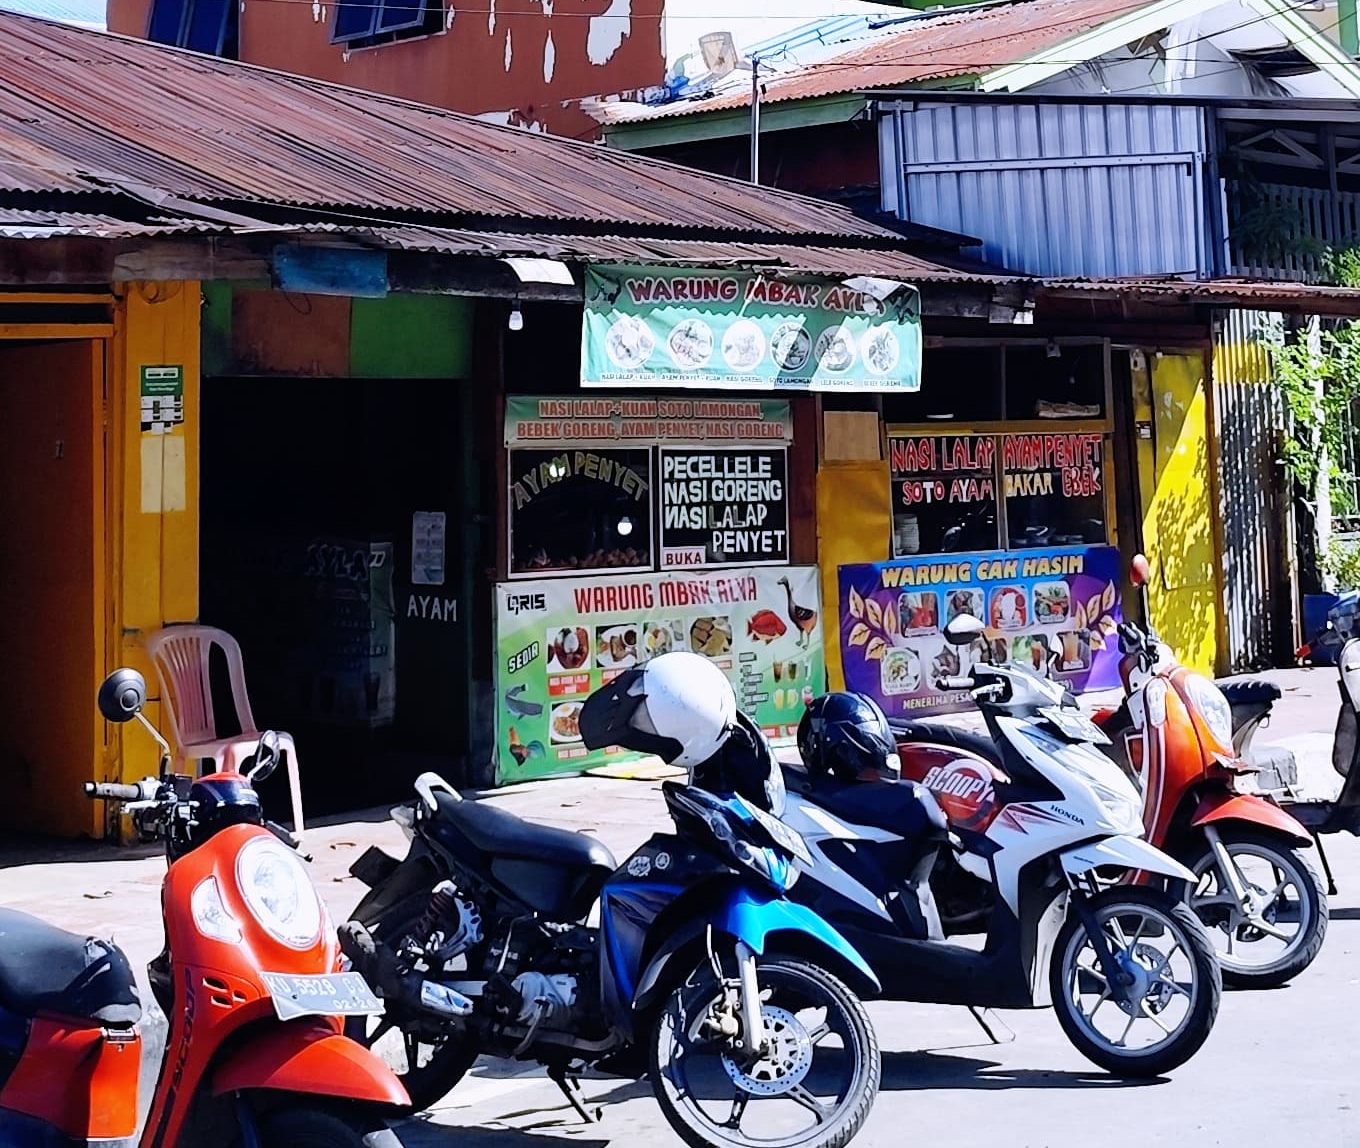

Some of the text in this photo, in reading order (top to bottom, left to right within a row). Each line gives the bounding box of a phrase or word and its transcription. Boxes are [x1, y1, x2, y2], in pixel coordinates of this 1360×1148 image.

[627, 278, 737, 302] WARUNG
[745, 279, 821, 307] MBAK
[541, 402, 572, 418] NASI
[659, 402, 691, 418] SOTO
[517, 422, 561, 438] BEBEK
[621, 422, 655, 438] AYAM
[706, 423, 734, 438] NASI
[737, 423, 784, 438] GORENG
[891, 437, 995, 471] NASI LALAP
[1003, 434, 1102, 470] AYAM PENYET
[664, 456, 771, 479] PECEL LELE
[514, 451, 649, 510] AYAM PENYET
[664, 480, 782, 504] NASI GORENG
[902, 479, 994, 505] SOTO AYAM
[709, 504, 768, 528] LALAP
[712, 530, 785, 552] PENYET
[666, 552, 702, 565] BUKA
[881, 562, 971, 588] WARUNG
[1022, 555, 1084, 579] HASIM
[407, 594, 457, 622] AYAM
[506, 594, 547, 615] QRIS
[574, 583, 653, 614] WARUNG
[659, 579, 713, 607] MBAK
[903, 692, 975, 710] MENERIMA PESA
[921, 766, 995, 803] SCOOPY
[1051, 804, 1085, 826] HONDA
[266, 976, 291, 993] KU
[293, 978, 337, 996] 5528
